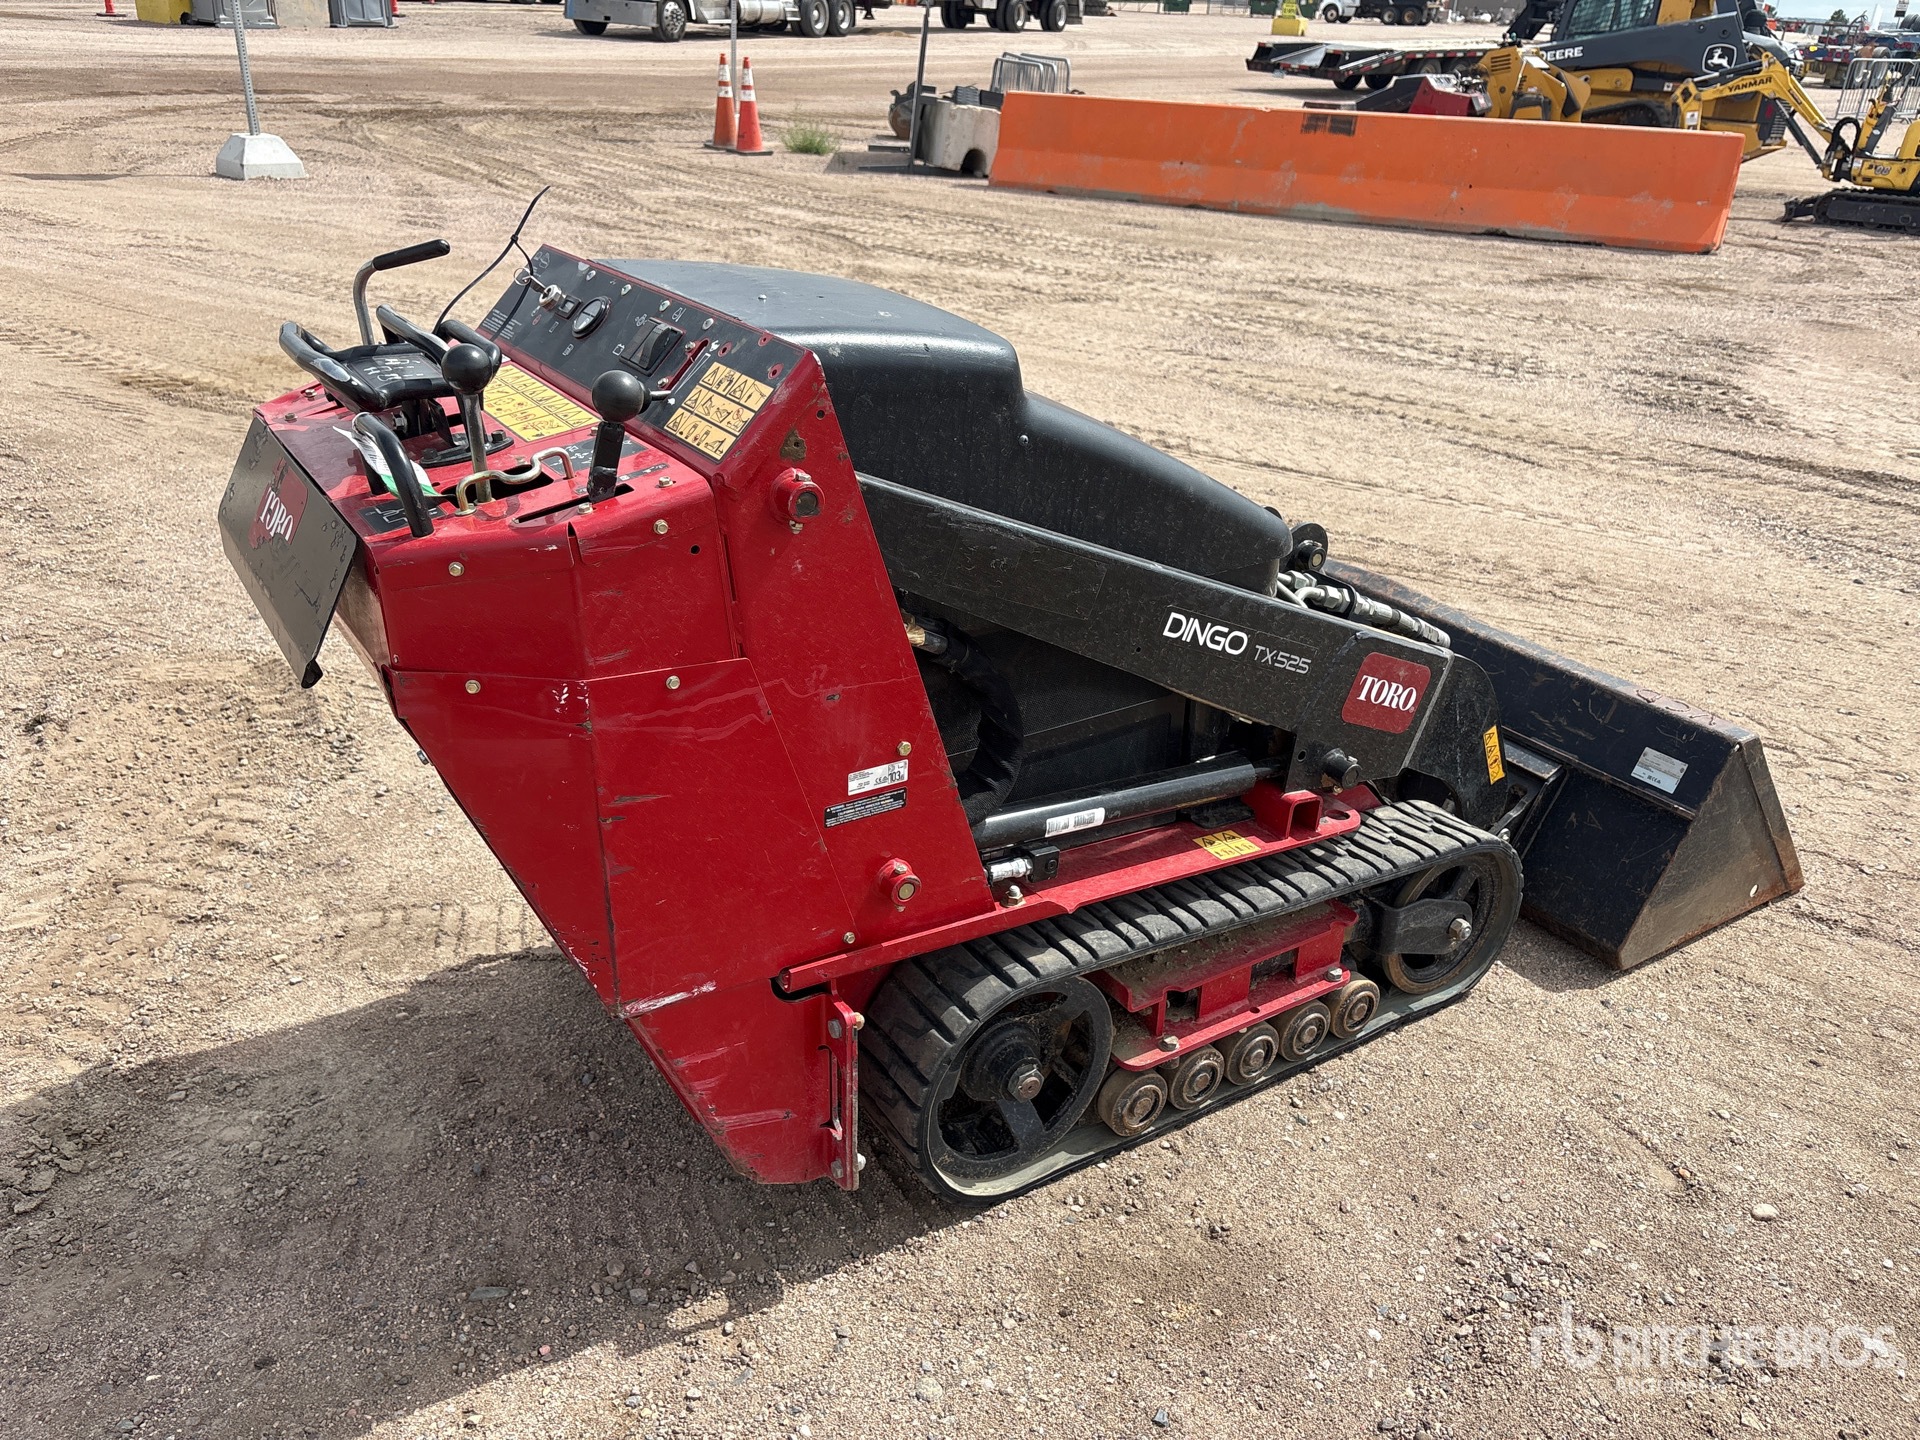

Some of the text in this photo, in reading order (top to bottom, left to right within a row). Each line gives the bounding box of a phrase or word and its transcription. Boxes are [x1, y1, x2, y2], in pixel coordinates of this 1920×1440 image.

[1540, 46, 1584, 61] DEERE
[1728, 76, 1773, 92] YANMAR
[1162, 611, 1249, 656] DINGO
[1357, 674, 1417, 712] TORO
